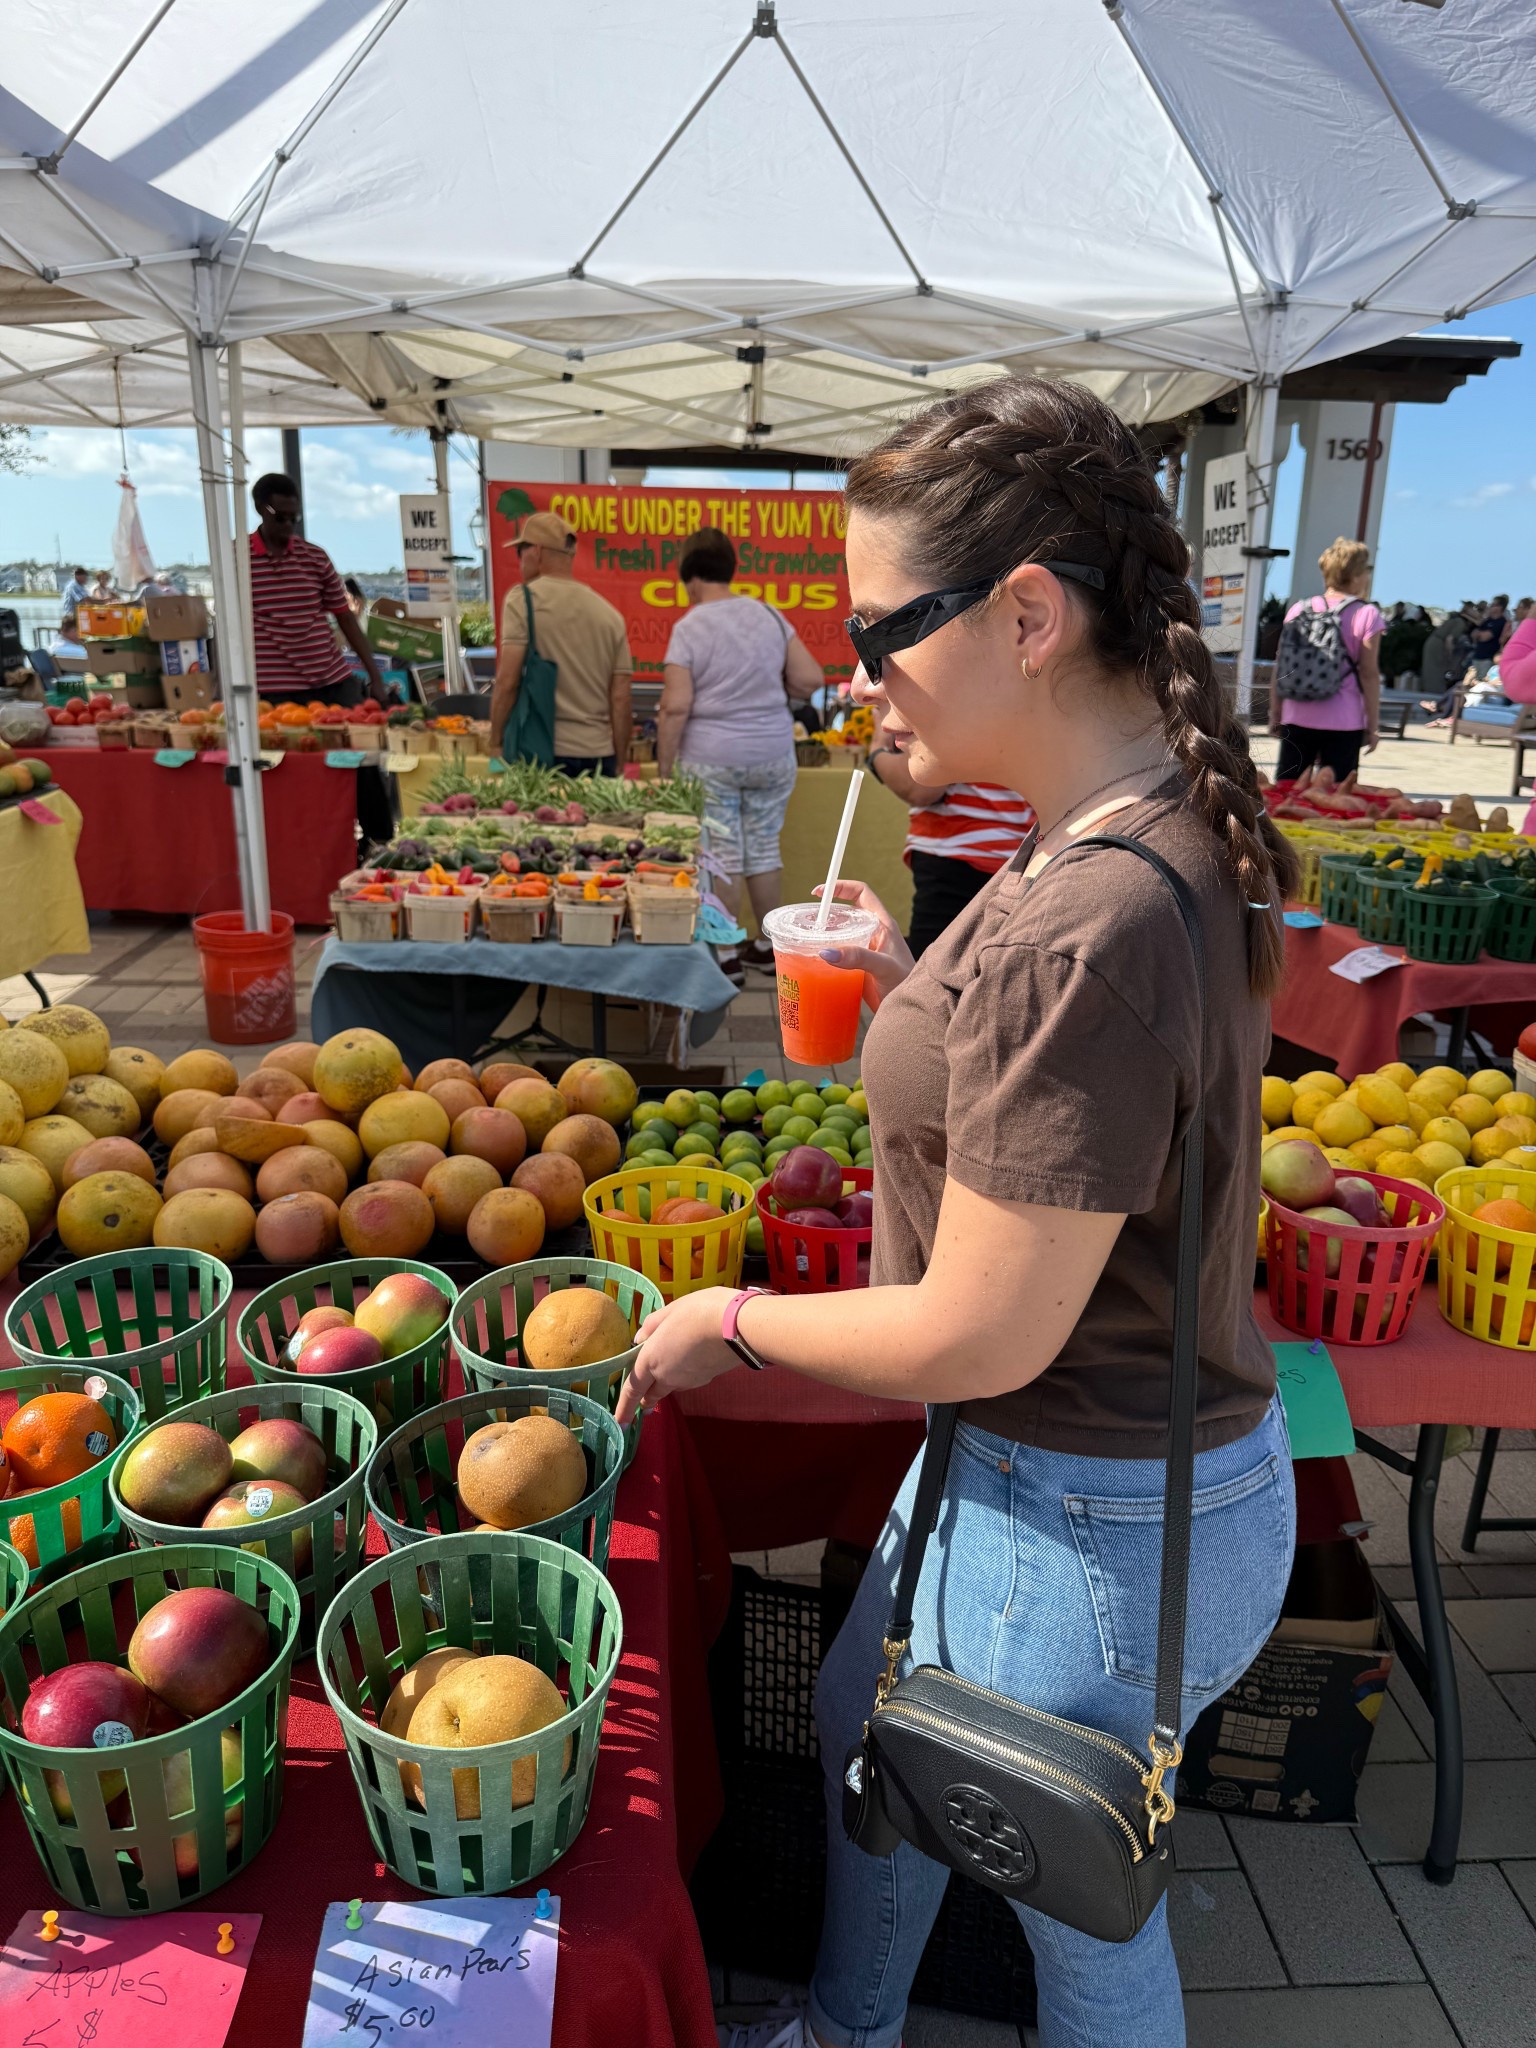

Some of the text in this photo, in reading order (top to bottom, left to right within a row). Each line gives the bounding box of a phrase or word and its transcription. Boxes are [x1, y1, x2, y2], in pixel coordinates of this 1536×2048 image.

[1214, 480, 1236, 512] WE
[410, 510, 437, 529] WE
[623, 497, 702, 536] UNDER
[706, 499, 751, 538] THE
[756, 500, 812, 539] YUM
[817, 501, 848, 540] YU
[405, 538, 448, 551] ACCEPT
[1204, 522, 1247, 548] ACCEPT
[595, 538, 656, 572] Fresh
[641, 579, 839, 610] CIUS
[1277, 1694, 1321, 1704] EXPORTED
[1272, 1720, 1289, 1730] 200
[351, 1954, 452, 1993] Asian
